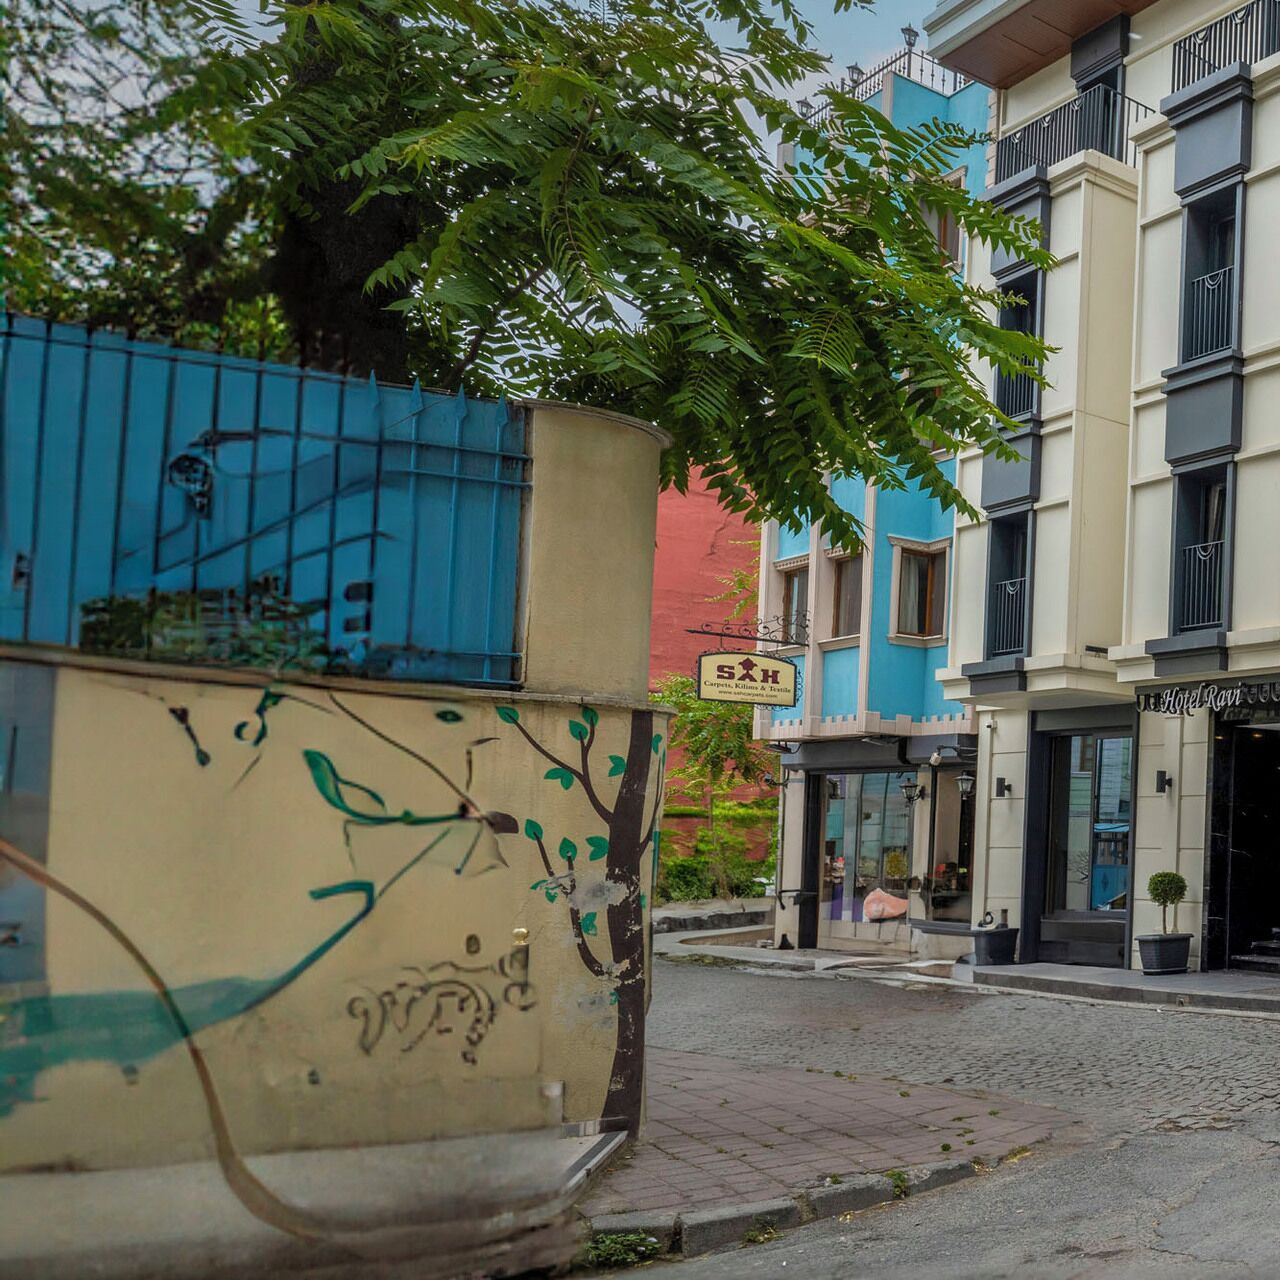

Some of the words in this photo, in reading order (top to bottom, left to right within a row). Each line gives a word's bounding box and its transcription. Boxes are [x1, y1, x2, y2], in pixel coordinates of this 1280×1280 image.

[703, 680, 734, 689] Carpets,
[735, 683, 758, 691] Kilims
[1161, 682, 1205, 712] Hotel
[1201, 681, 1242, 712] Ravi
